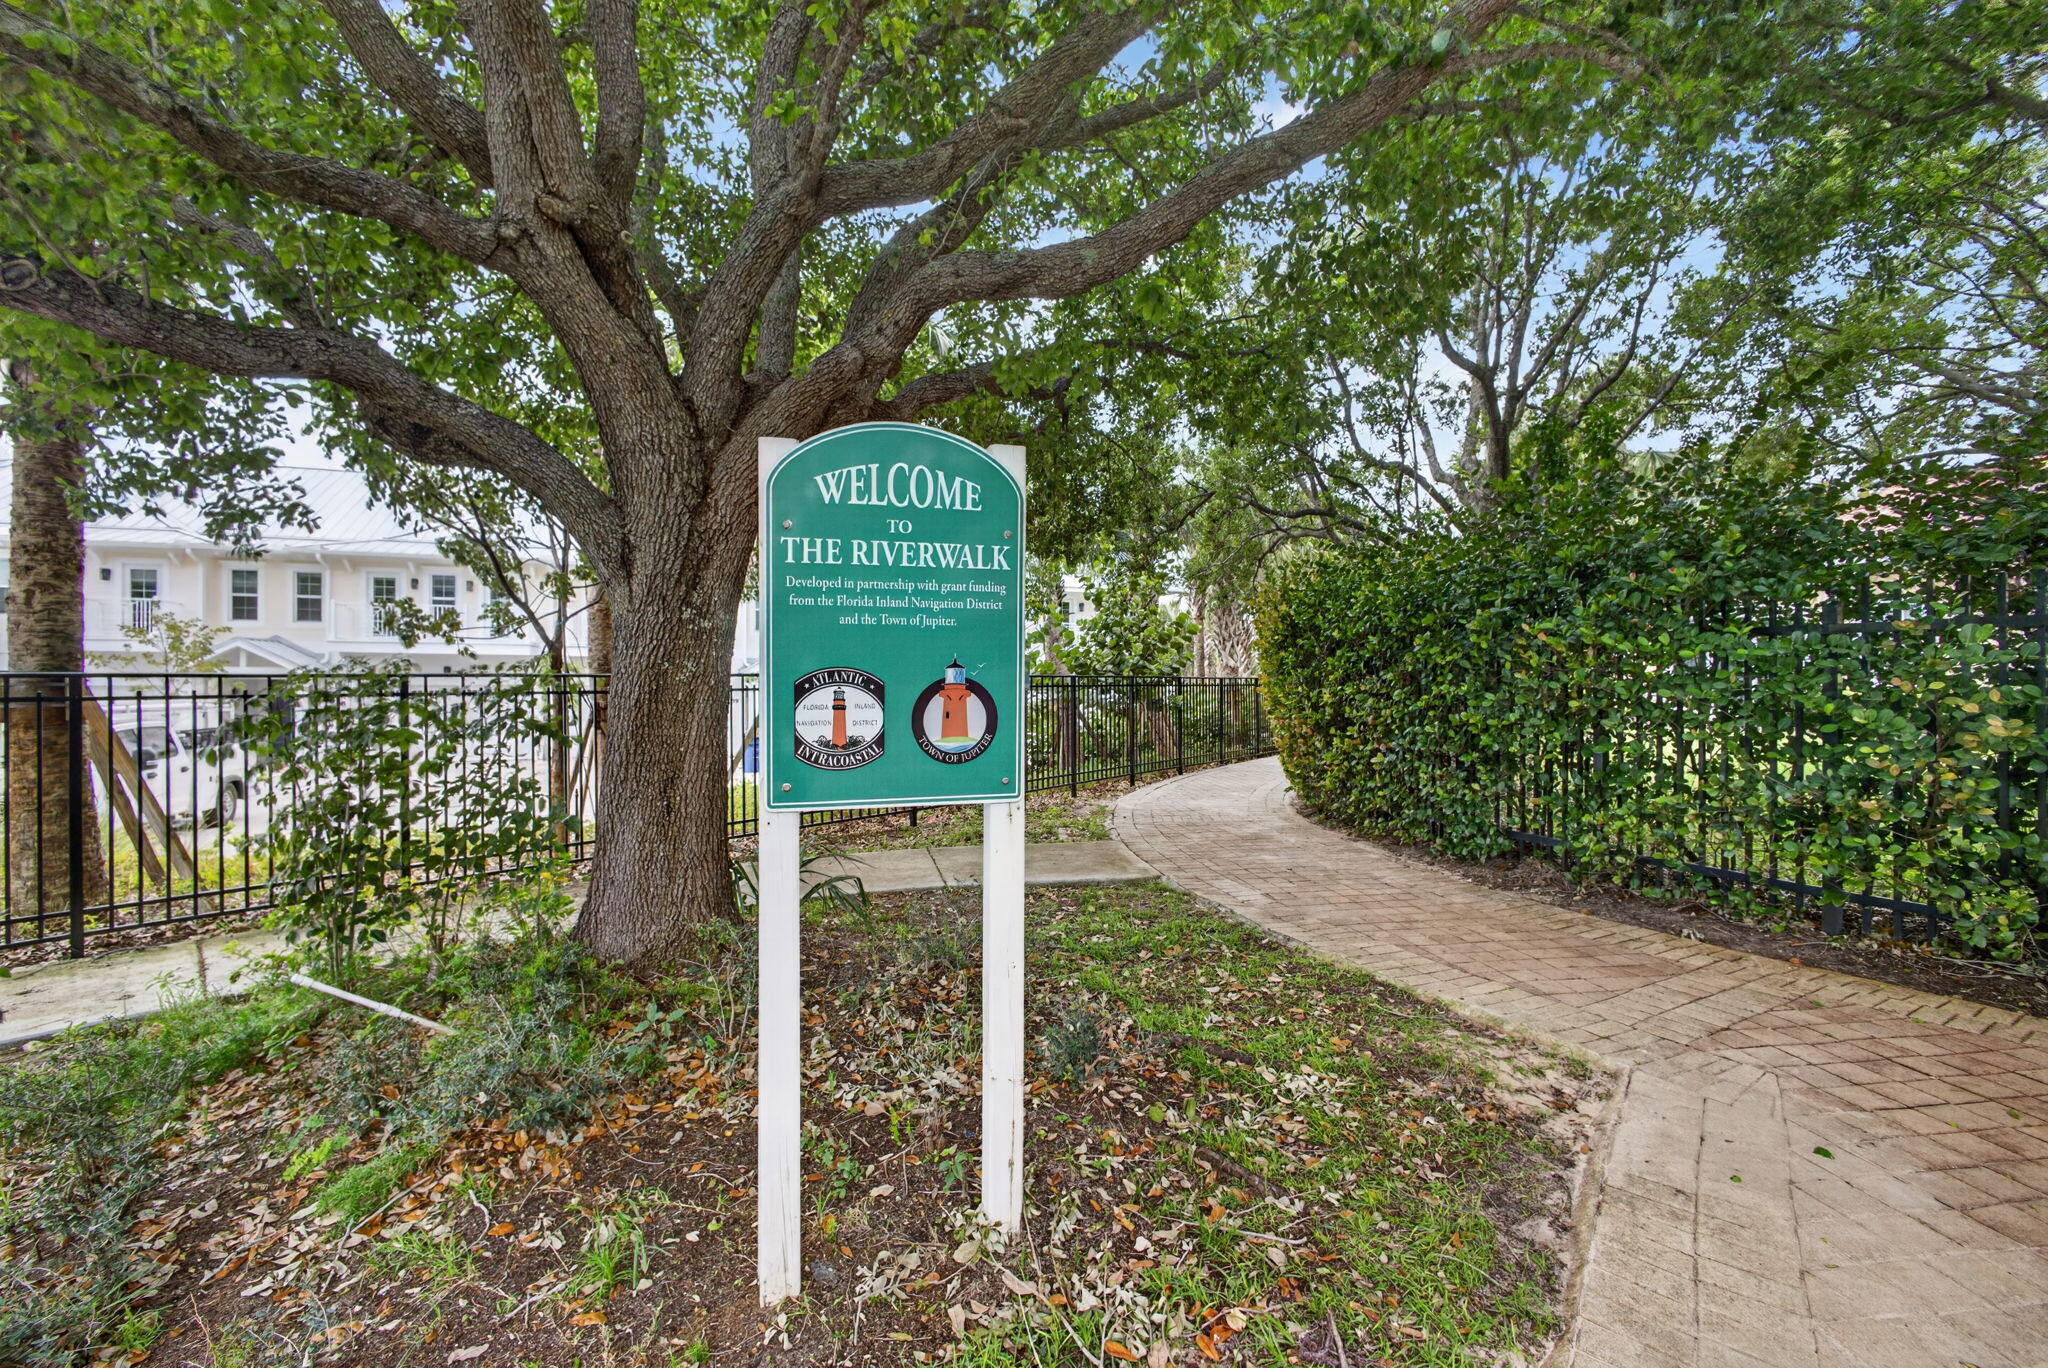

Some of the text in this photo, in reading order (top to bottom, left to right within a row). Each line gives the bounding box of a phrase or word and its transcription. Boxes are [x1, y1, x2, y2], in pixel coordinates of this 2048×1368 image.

[814, 462, 982, 511] WELCOME
[887, 519, 912, 534] TO
[780, 536, 1011, 570] THE RIVERWALK
[785, 575, 1006, 595] Developed in partnership with grant funding
[789, 593, 1003, 612] from the Florida Inland Navigation District
[839, 613, 957, 628] and the Town of Jupiter.
[811, 671, 867, 687] ATLANTIC
[803, 703, 829, 711] FLORIDA
[796, 719, 878, 727] NAVIGATION DISTRICT
[797, 744, 883, 767] INTRACOASTAL
[918, 733, 993, 763] TOWN OF JUPITER
